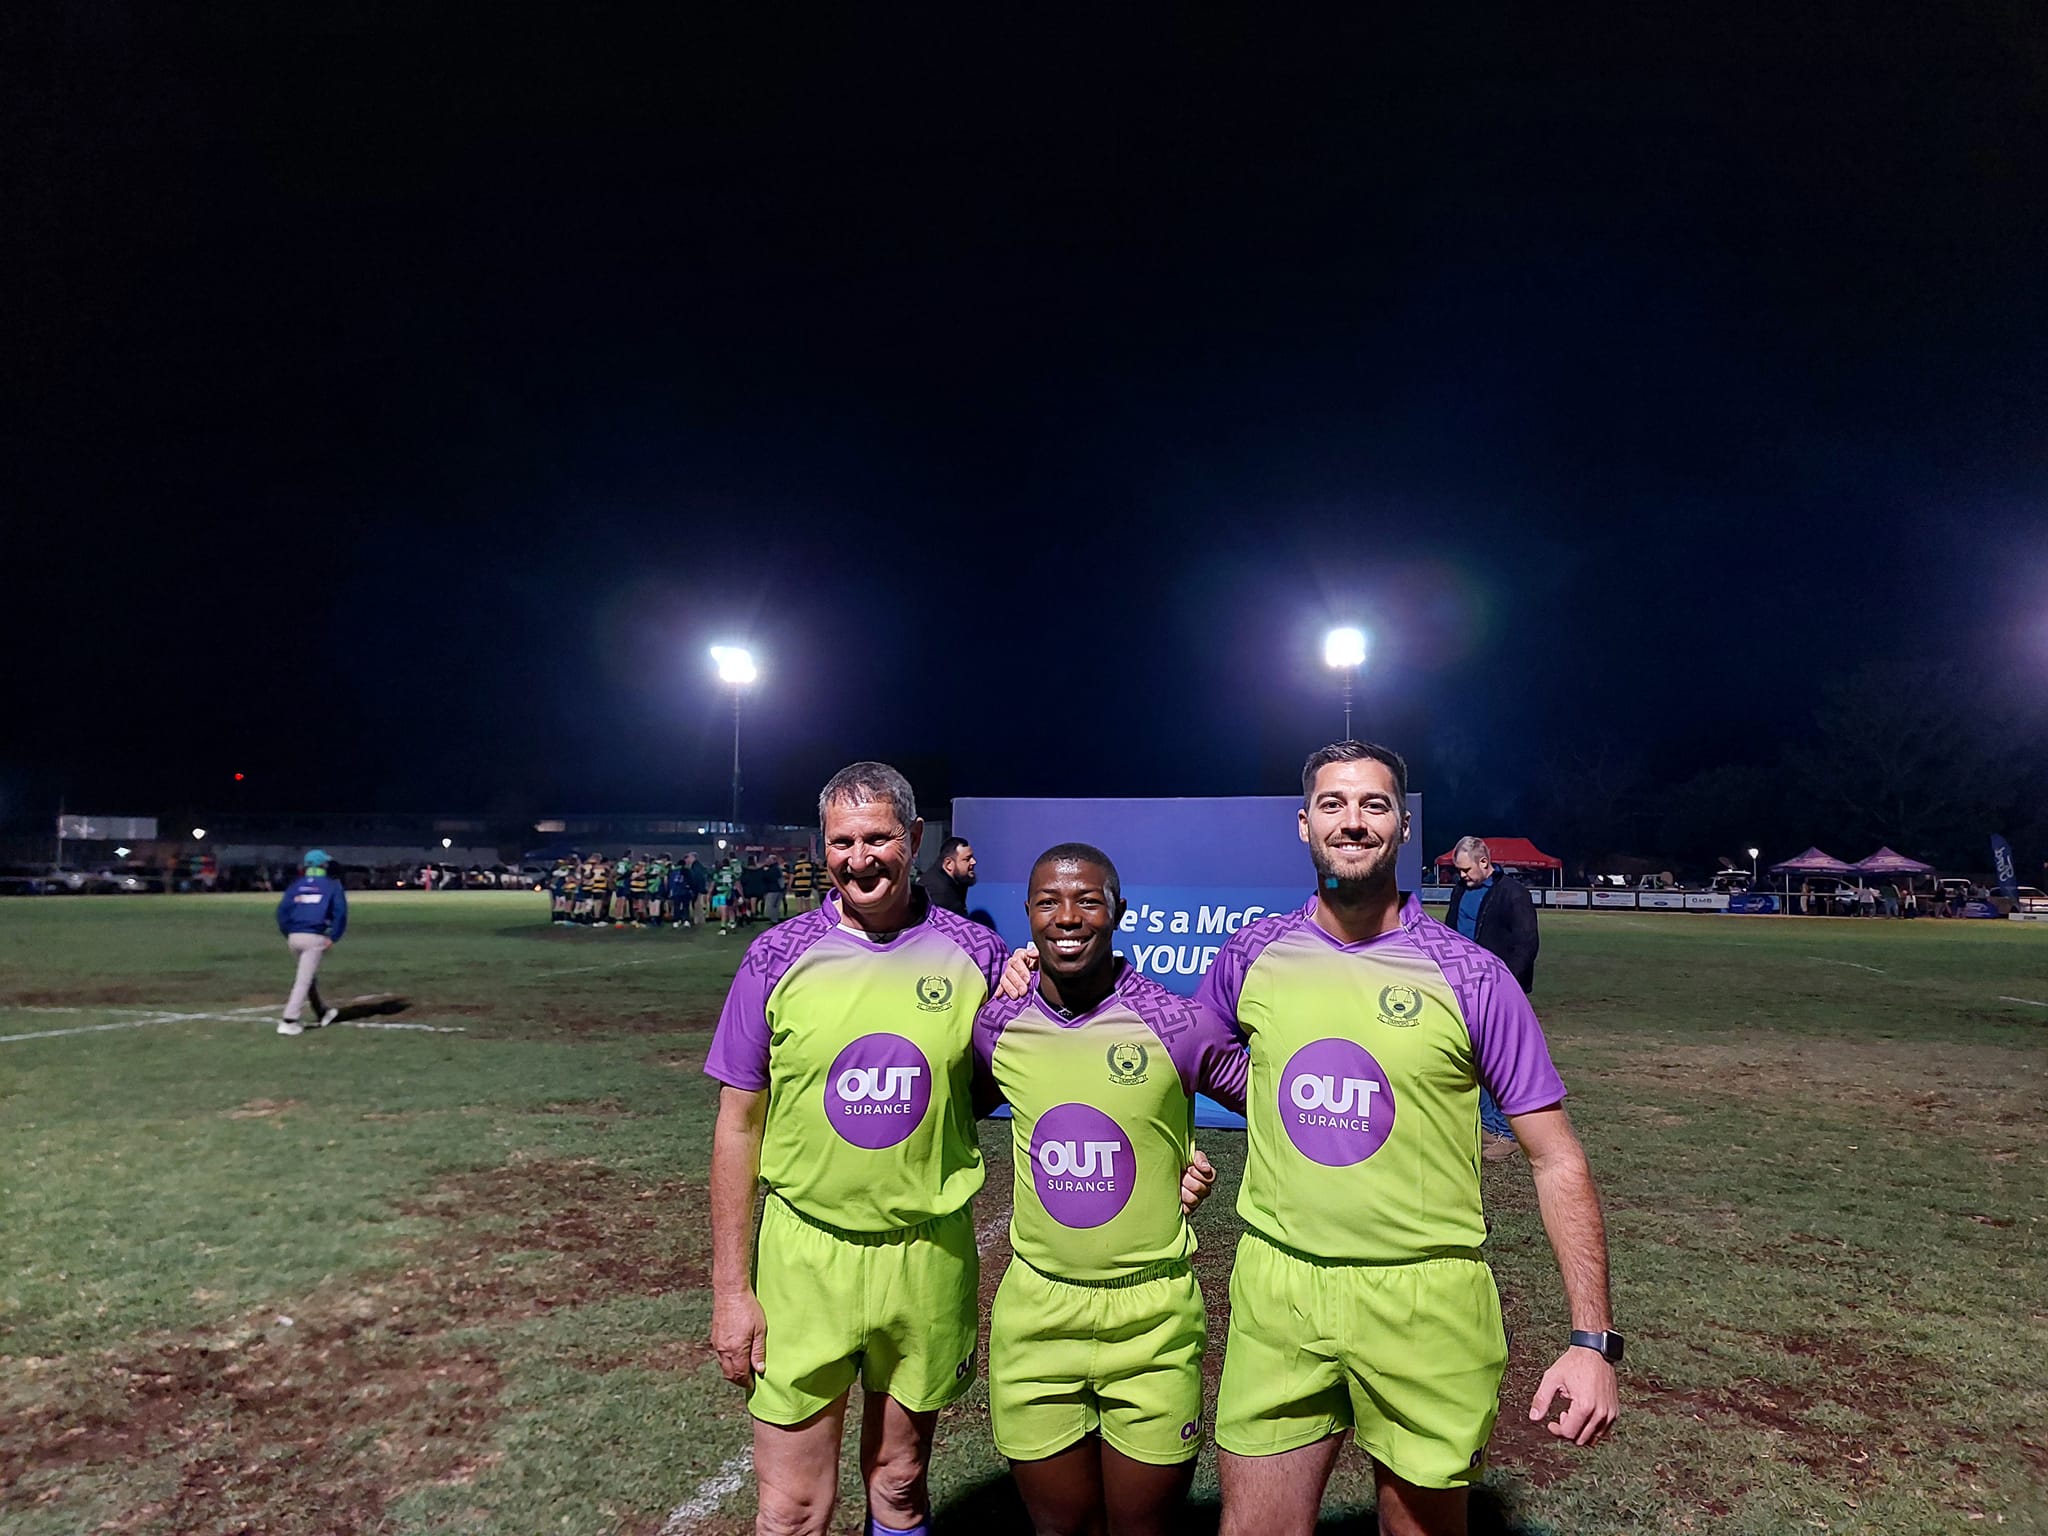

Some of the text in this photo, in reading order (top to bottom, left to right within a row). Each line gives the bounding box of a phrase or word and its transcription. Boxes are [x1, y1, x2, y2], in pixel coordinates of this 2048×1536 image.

[1119, 904, 1282, 935] e's a McG
[836, 1067, 921, 1102] OUT
[1290, 1073, 1381, 1118] OUT
[844, 1103, 911, 1116] SURANCE
[1298, 1112, 1370, 1132] SURANCE
[1038, 1140, 1121, 1178] OUT
[1047, 1179, 1116, 1192] SURANCE
